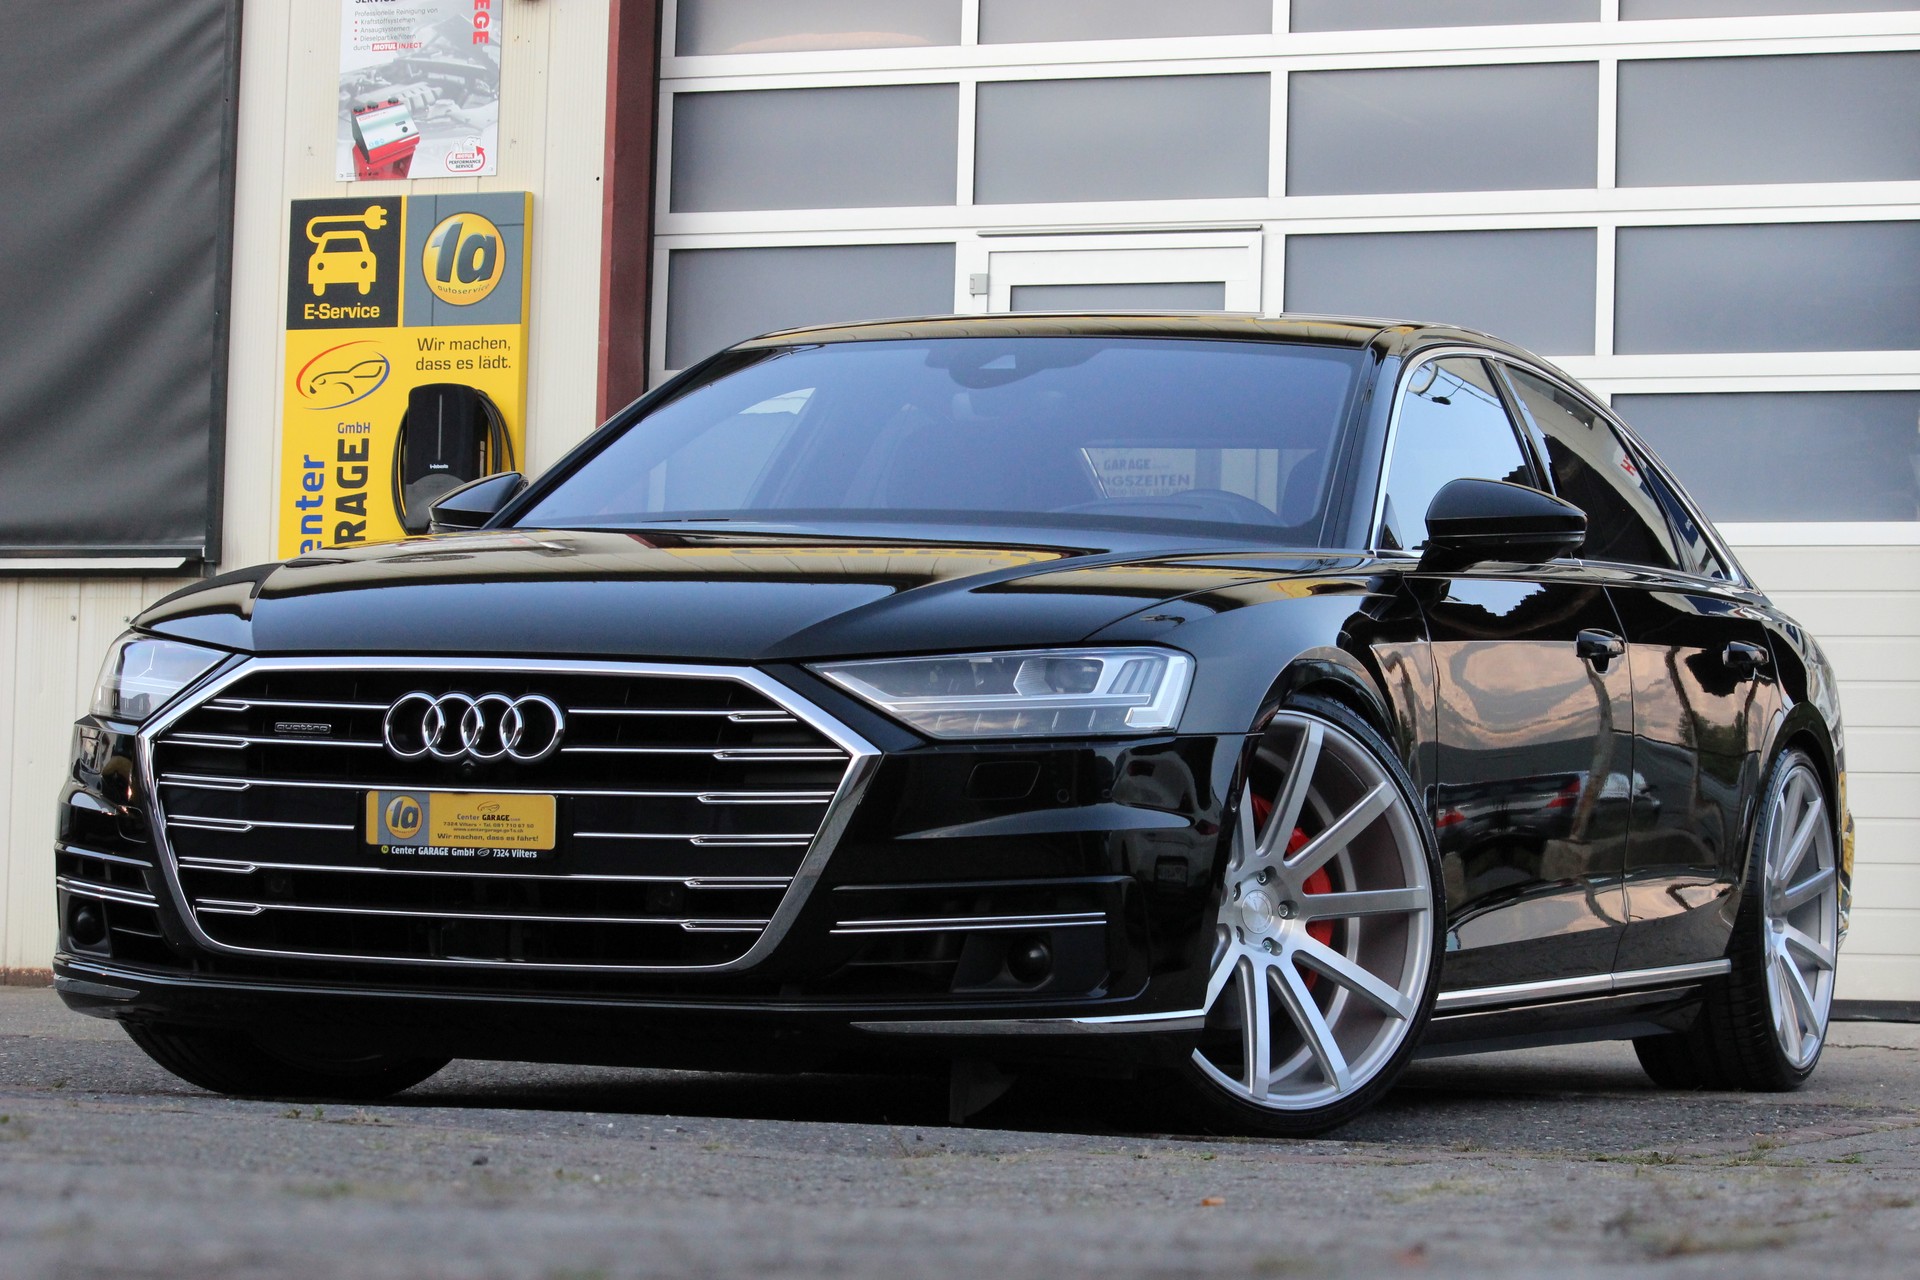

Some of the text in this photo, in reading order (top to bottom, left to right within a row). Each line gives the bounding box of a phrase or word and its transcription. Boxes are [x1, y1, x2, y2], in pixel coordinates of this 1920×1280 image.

[354, 9, 395, 17] Professionelle
[396, 8, 426, 16] Reinigung
[360, 17, 416, 25] Kraftstoffsystemen
[360, 26, 410, 34] Ansaugsystemen
[372, 43, 397, 51] MOTUL
[304, 302, 380, 320] E-Service
[417, 336, 511, 351] Wir machen,
[415, 355, 511, 371] dass es lädt.
[337, 422, 371, 434] GmbH
[1103, 458, 1152, 471] GARAGE
[334, 438, 370, 545] RAGE
[276, 724, 328, 732] quattro
[456, 813, 480, 821] Center
[482, 814, 510, 822] GARAGE
[453, 833, 485, 841] machen,
[391, 846, 416, 855] Center
[418, 847, 449, 856] GARAGE
[451, 847, 475, 856] GmbH
[492, 849, 510, 858] 7324
[511, 849, 537, 858] Vilters
